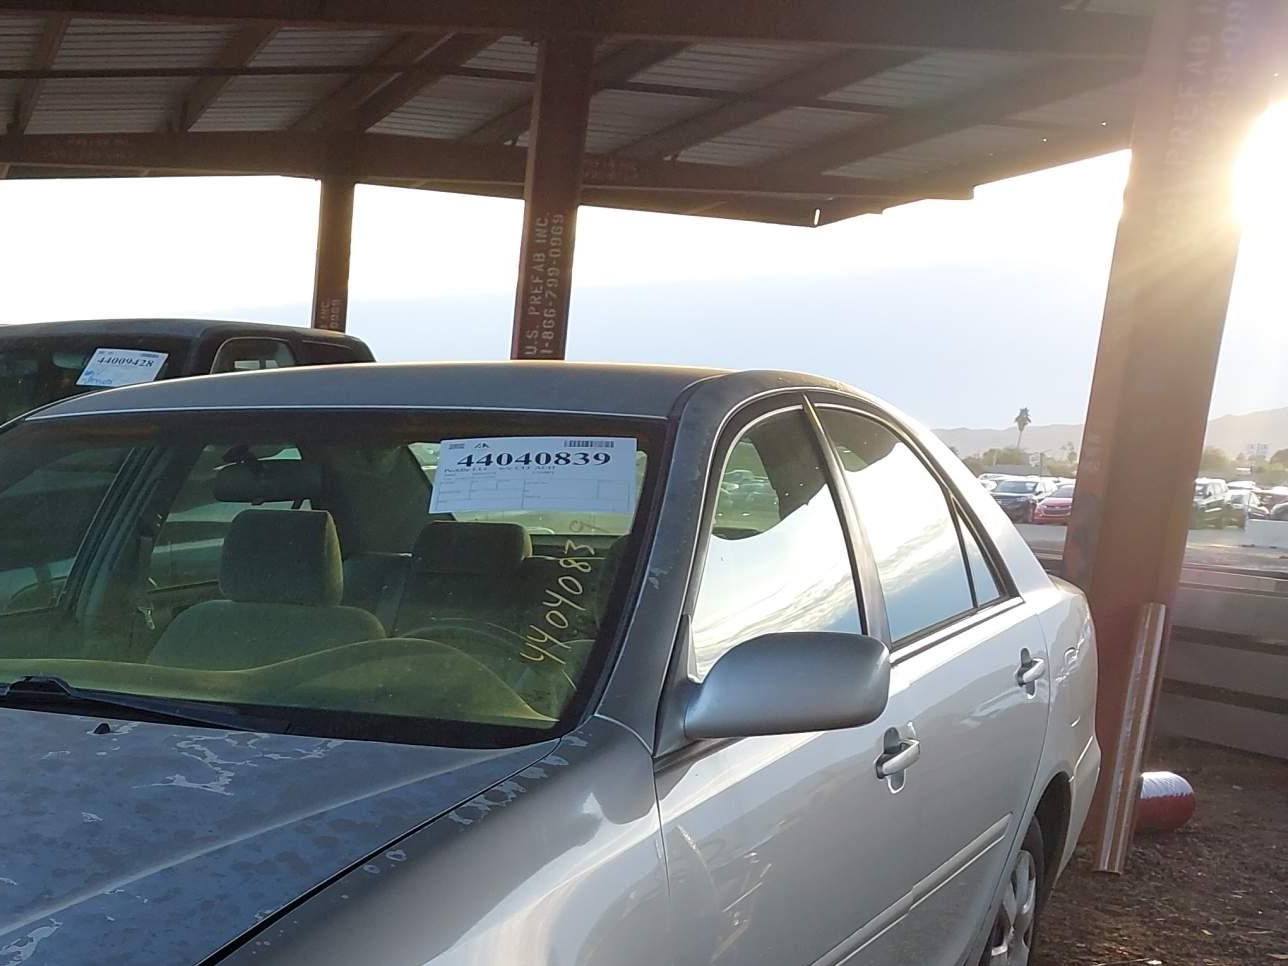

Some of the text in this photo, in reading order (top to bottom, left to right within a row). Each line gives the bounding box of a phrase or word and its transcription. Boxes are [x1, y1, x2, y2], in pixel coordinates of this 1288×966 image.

[527, 252, 547, 316] PREFAB
[97, 356, 155, 368] 44009428
[456, 451, 612, 467] 44040839
